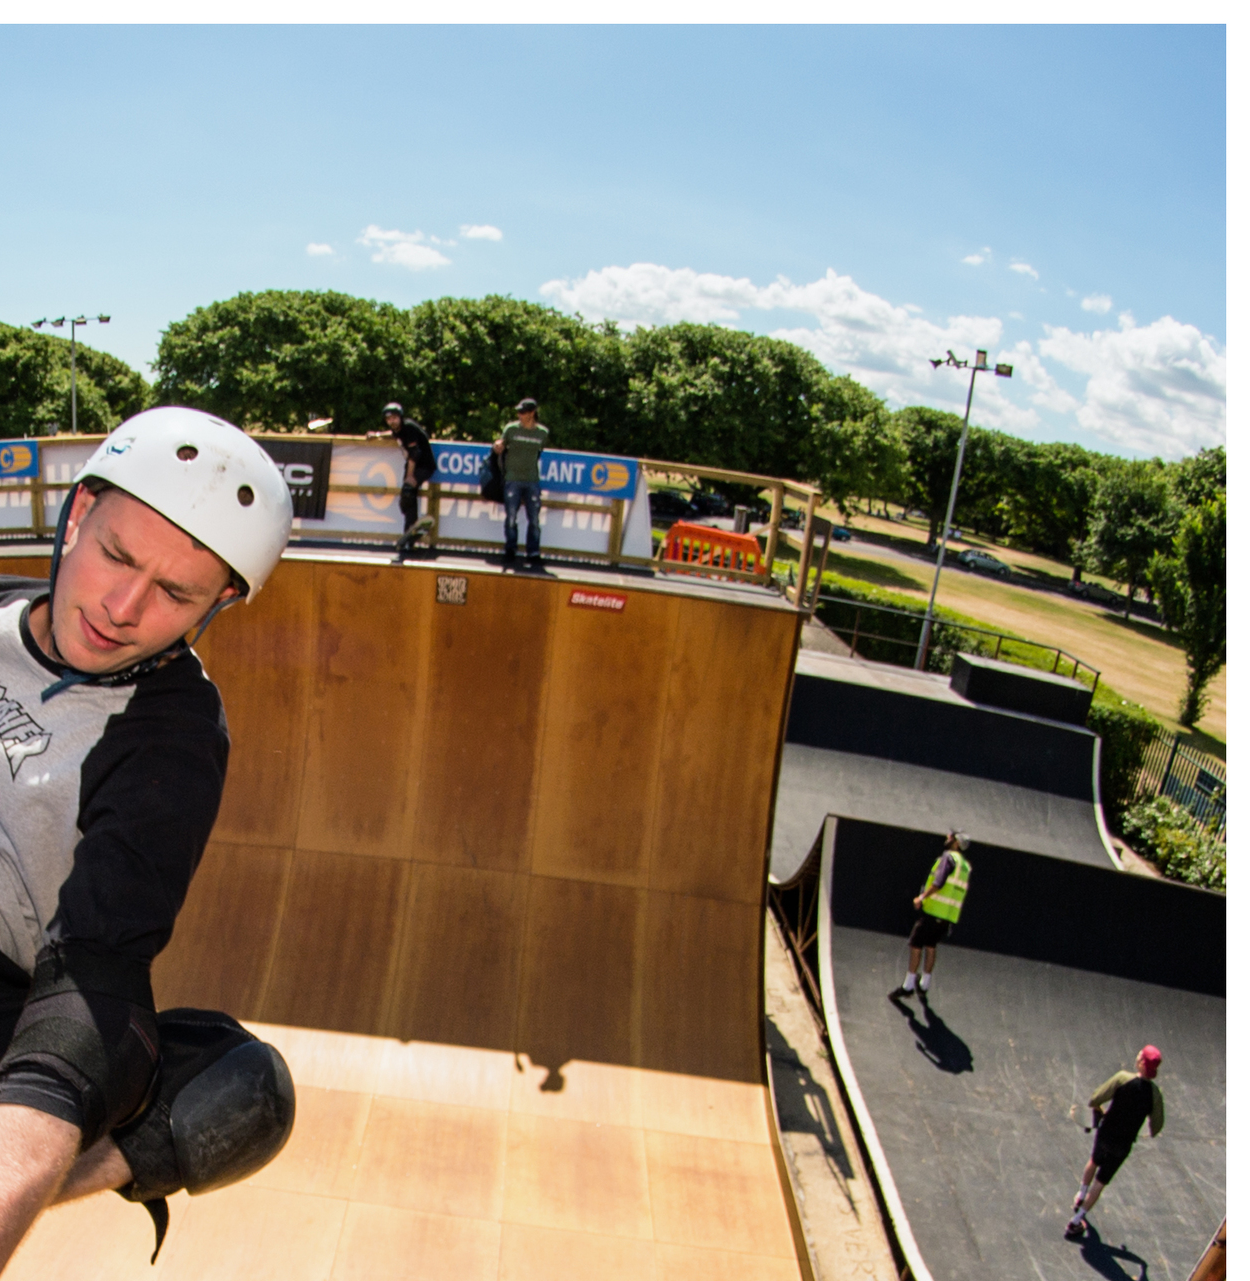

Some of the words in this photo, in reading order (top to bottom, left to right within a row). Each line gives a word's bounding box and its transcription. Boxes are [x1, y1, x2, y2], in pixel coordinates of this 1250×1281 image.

[437, 452, 483, 475] COSH
[538, 460, 586, 485] LANT
[571, 591, 625, 610] Skatelite
